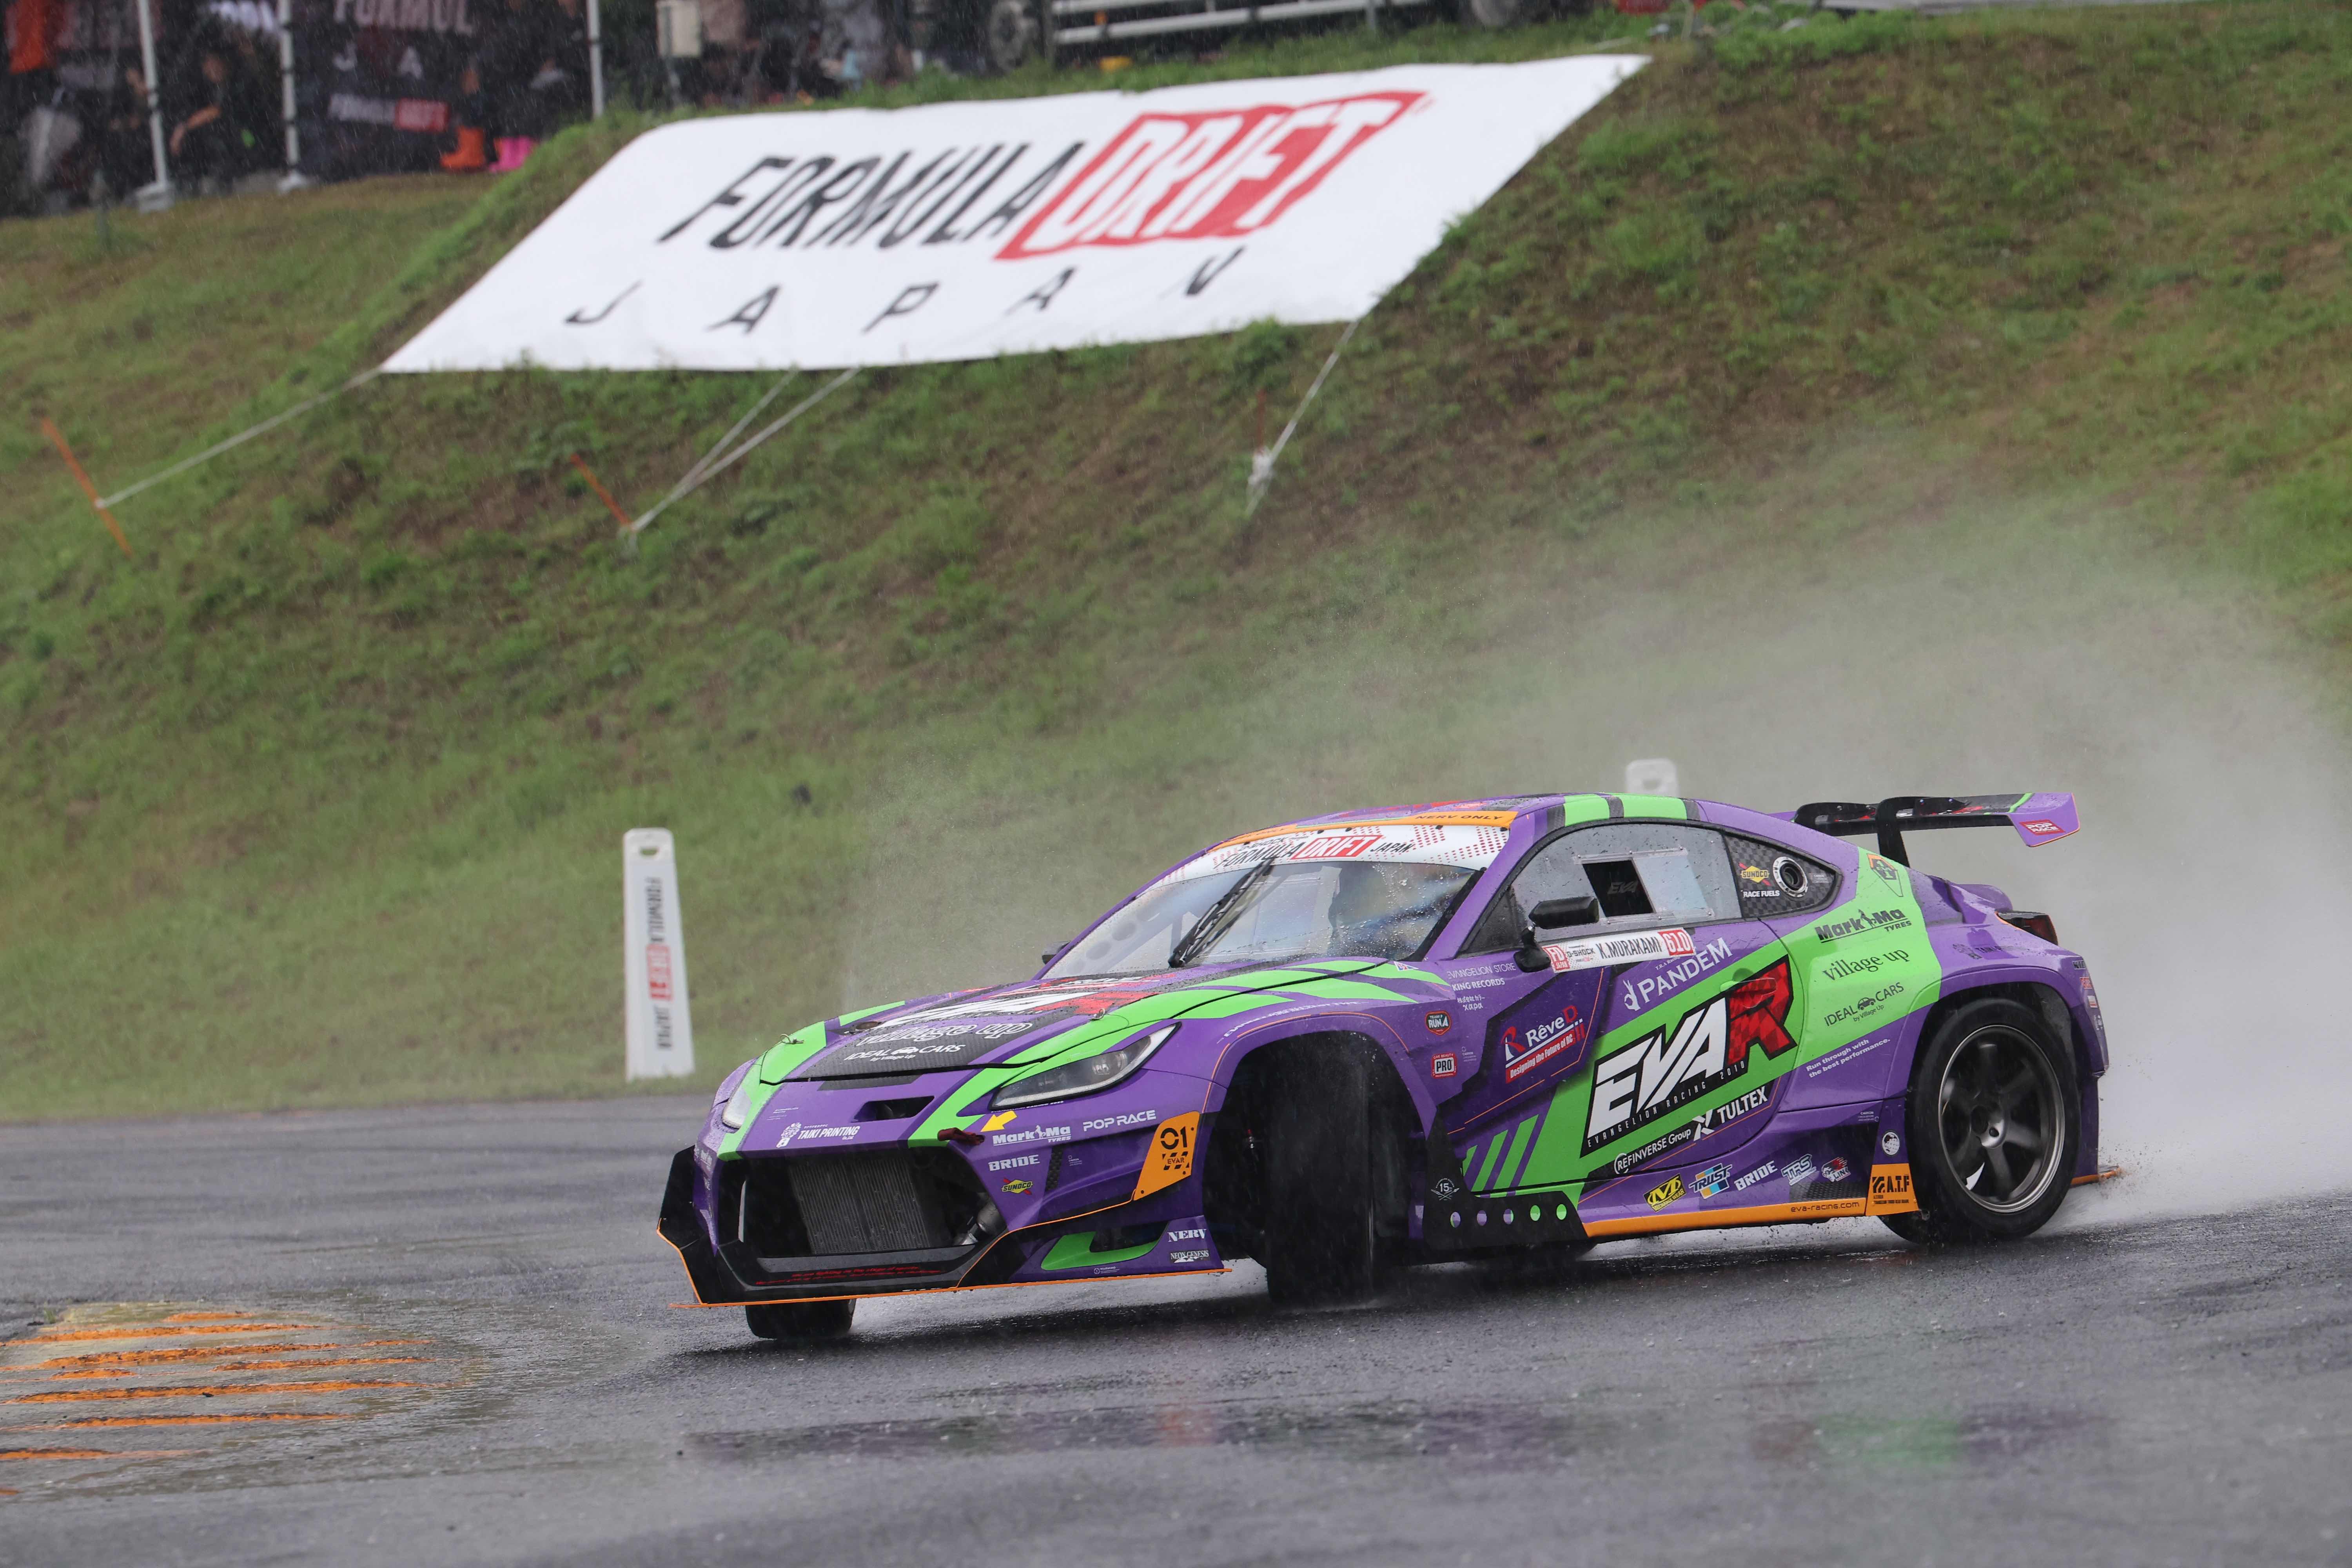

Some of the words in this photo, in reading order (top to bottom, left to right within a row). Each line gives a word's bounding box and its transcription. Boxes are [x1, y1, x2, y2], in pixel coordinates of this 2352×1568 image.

[655, 141, 1086, 249] FORMULA
[1007, 97, 1411, 254] DRIFT
[1213, 842, 1306, 869] FORMULA
[1292, 835, 1381, 859] DRIFT
[1370, 842, 1415, 853] JAPAN
[1741, 870, 1769, 878] SUNOCO
[1815, 918, 1866, 941] Mark
[1871, 909, 1906, 924] Ma
[1884, 920, 1912, 932] TYRES
[1544, 946, 1565, 962] FD
[1595, 936, 1663, 960] K.MURAKAMI
[1446, 965, 1493, 979] EVANGELION
[1494, 963, 1516, 973] STORE
[1637, 937, 1733, 1004] PANDEM
[1822, 959, 1884, 981] village
[1882, 949, 1910, 962] up
[1452, 982, 1471, 991] KING
[1472, 978, 1505, 989] RECORDS
[1824, 1005, 1858, 1027] IDEAL
[1875, 982, 1904, 1002] CARS
[1859, 1008, 1877, 1019] Village
[856, 1024, 978, 1046] village
[975, 1023, 1033, 1039] up
[844, 1049, 891, 1061] IDEAL
[919, 1044, 966, 1054] CARS
[1510, 1057, 1536, 1079] Designing
[1535, 1052, 1545, 1063] the
[1544, 1047, 1561, 1058] Future
[1561, 1040, 1566, 1048] of
[1566, 1033, 1573, 1045] RC
[1806, 1061, 1822, 1072] Run
[1822, 1047, 1852, 1064] through
[1851, 1039, 1870, 1050] with
[1809, 1069, 1822, 1078] the
[1822, 1060, 1840, 1072] best
[1840, 1038, 1891, 1065] performance.
[1436, 1059, 1452, 1073] PRO
[1588, 1106, 1658, 1147] EVANGELION
[1666, 1083, 1706, 1108] RACING
[1720, 1060, 1745, 1080] 2010
[1717, 1086, 1768, 1124] TULTEX
[1082, 1117, 1115, 1132] POP
[1116, 1109, 1156, 1126] RACE
[797, 1129, 820, 1140] TAIKI
[818, 1125, 861, 1138] PRINTING
[992, 1131, 1035, 1145] Mark
[1045, 1126, 1071, 1137] Ma
[1160, 1125, 1188, 1150] 01
[1616, 1135, 1667, 1172] REFINVERSE
[1668, 1128, 1691, 1145] Group
[987, 1154, 1040, 1172] BRIDE
[1782, 1155, 1811, 1180] TRS
[1003, 1181, 1032, 1191] SUNOCO
[1689, 1164, 1732, 1193] TRUST
[1734, 1160, 1778, 1191] BRIDE
[1439, 1183, 1450, 1192] 15
[1672, 1188, 1685, 1202] WEAR
[1791, 1201, 1860, 1212] eva-racing.com
[1166, 1229, 1208, 1242] NERV
[1170, 1250, 1186, 1260] NEON
